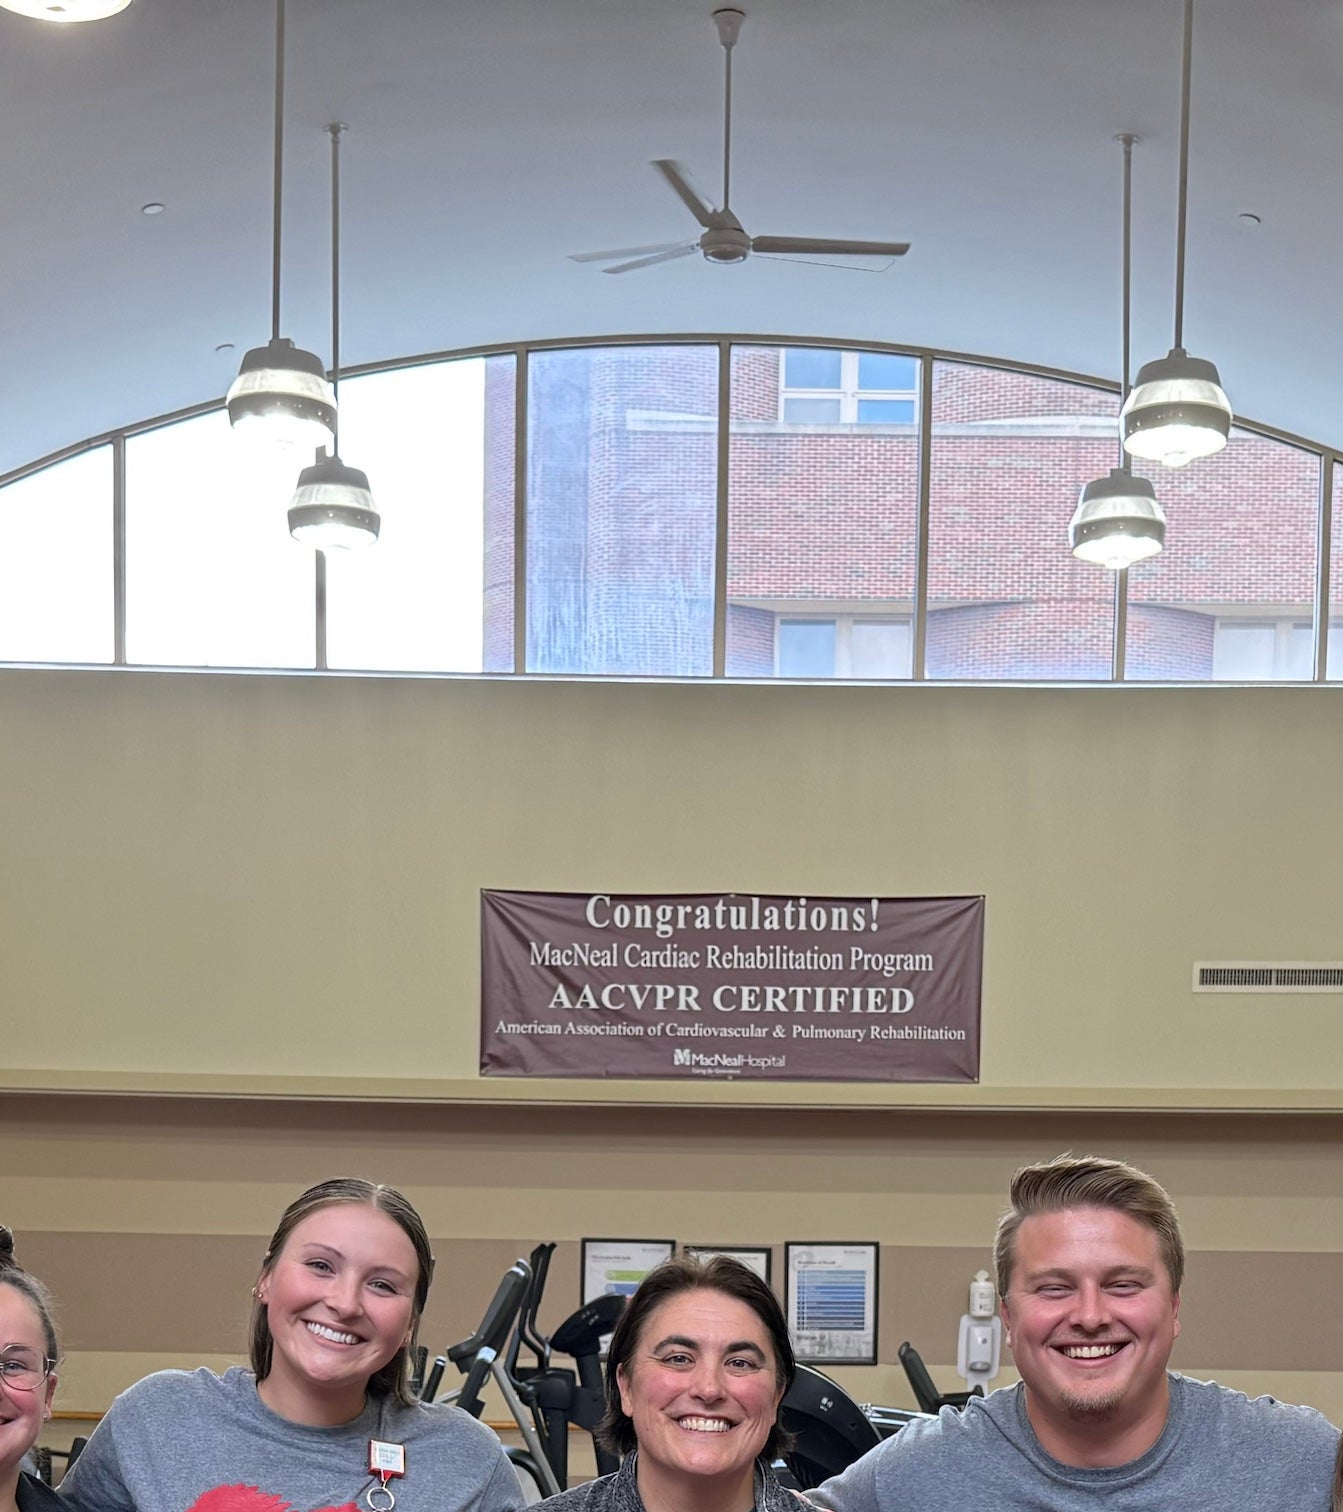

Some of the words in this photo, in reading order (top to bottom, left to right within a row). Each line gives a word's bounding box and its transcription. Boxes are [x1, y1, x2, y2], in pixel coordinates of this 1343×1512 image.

[586, 895, 879, 938] Congratulations!
[530, 942, 618, 967] MacNeal
[624, 943, 700, 969] Cardiac
[706, 945, 843, 971] Rehabilitation
[850, 947, 933, 977] Program
[549, 983, 702, 1011] AACVPR
[713, 985, 915, 1013] CERTIFIED
[495, 1020, 561, 1035] American
[564, 1021, 644, 1036] Association
[647, 1022, 664, 1036] of
[665, 1023, 768, 1038] Cardiovascular
[773, 1025, 786, 1038] &
[792, 1025, 866, 1042] Pulmonary
[870, 1026, 966, 1040] Rehabilitation
